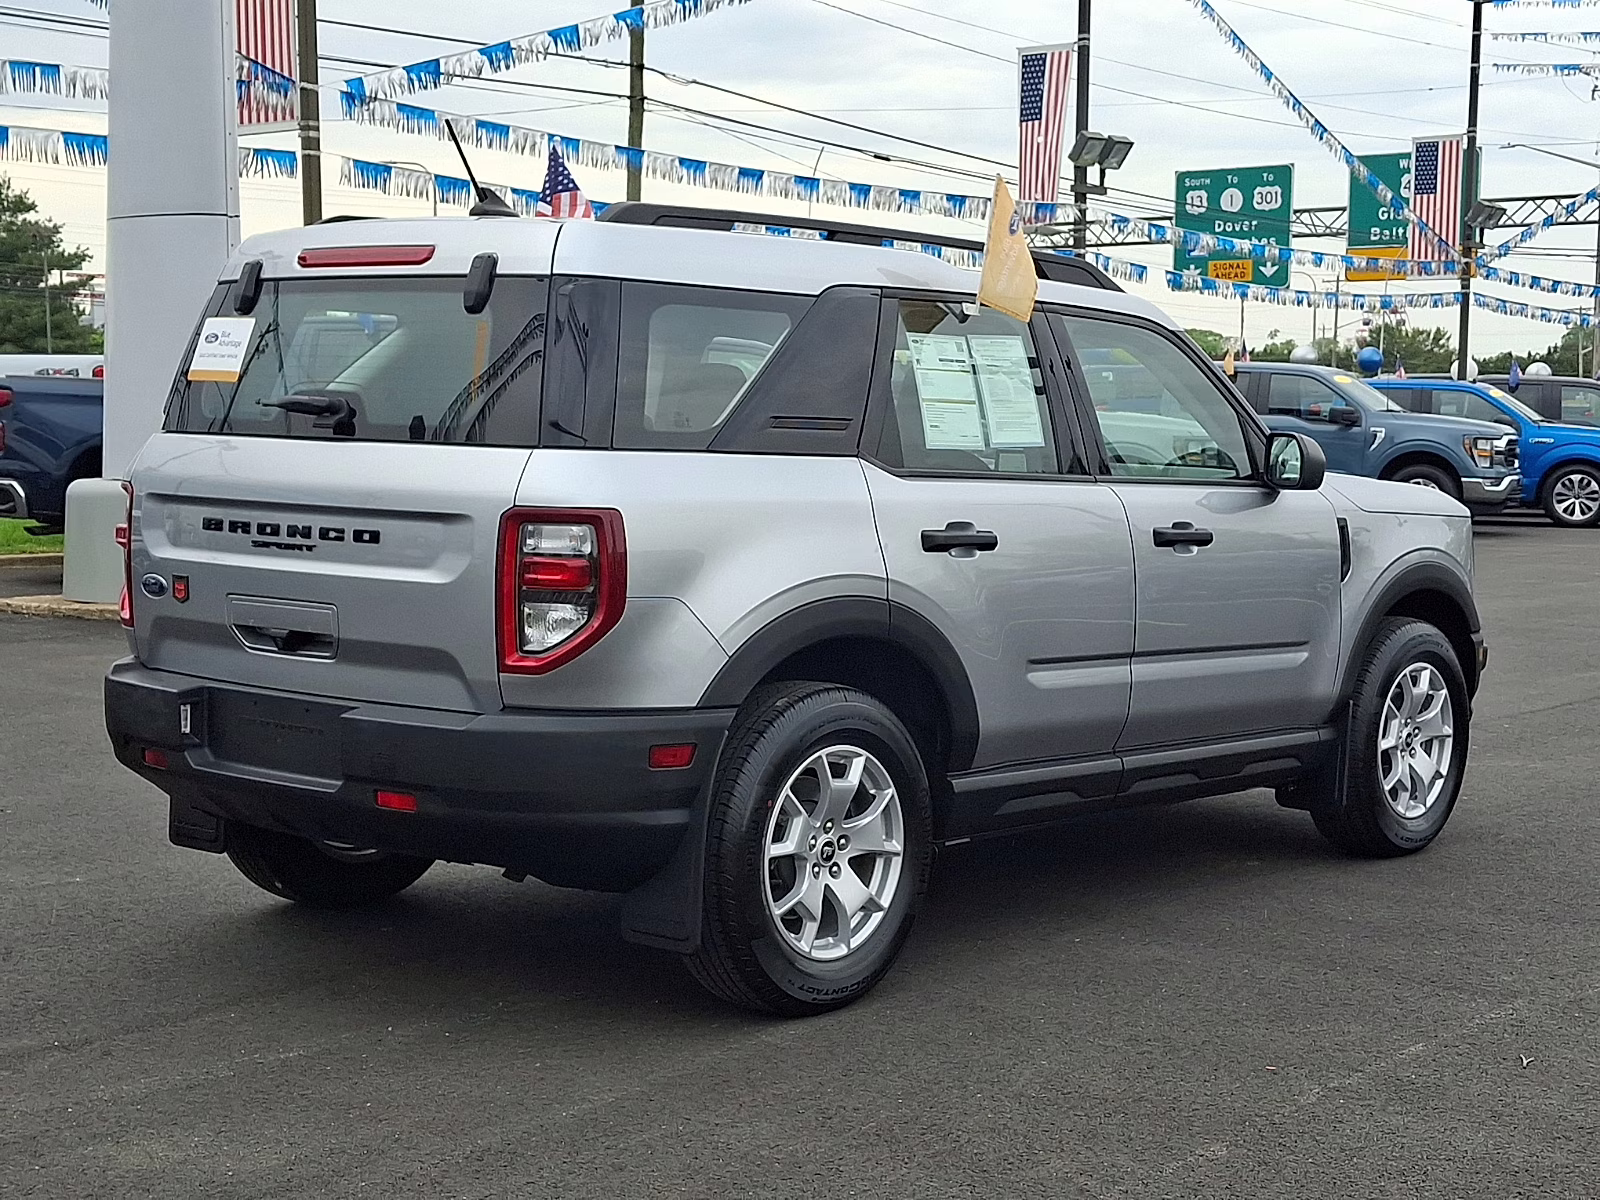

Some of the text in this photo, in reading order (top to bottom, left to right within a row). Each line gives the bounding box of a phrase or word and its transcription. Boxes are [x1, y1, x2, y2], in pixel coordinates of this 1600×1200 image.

[1184, 177, 1211, 187] SOUTH
[1190, 195, 1204, 209] 13
[1255, 190, 1279, 206] 301
[1214, 220, 1259, 233] Dover
[1213, 262, 1247, 272] SIGNAL
[1214, 270, 1247, 280] AHEAD
[202, 517, 381, 545] BRONCO
[250, 539, 317, 552] SPORT
